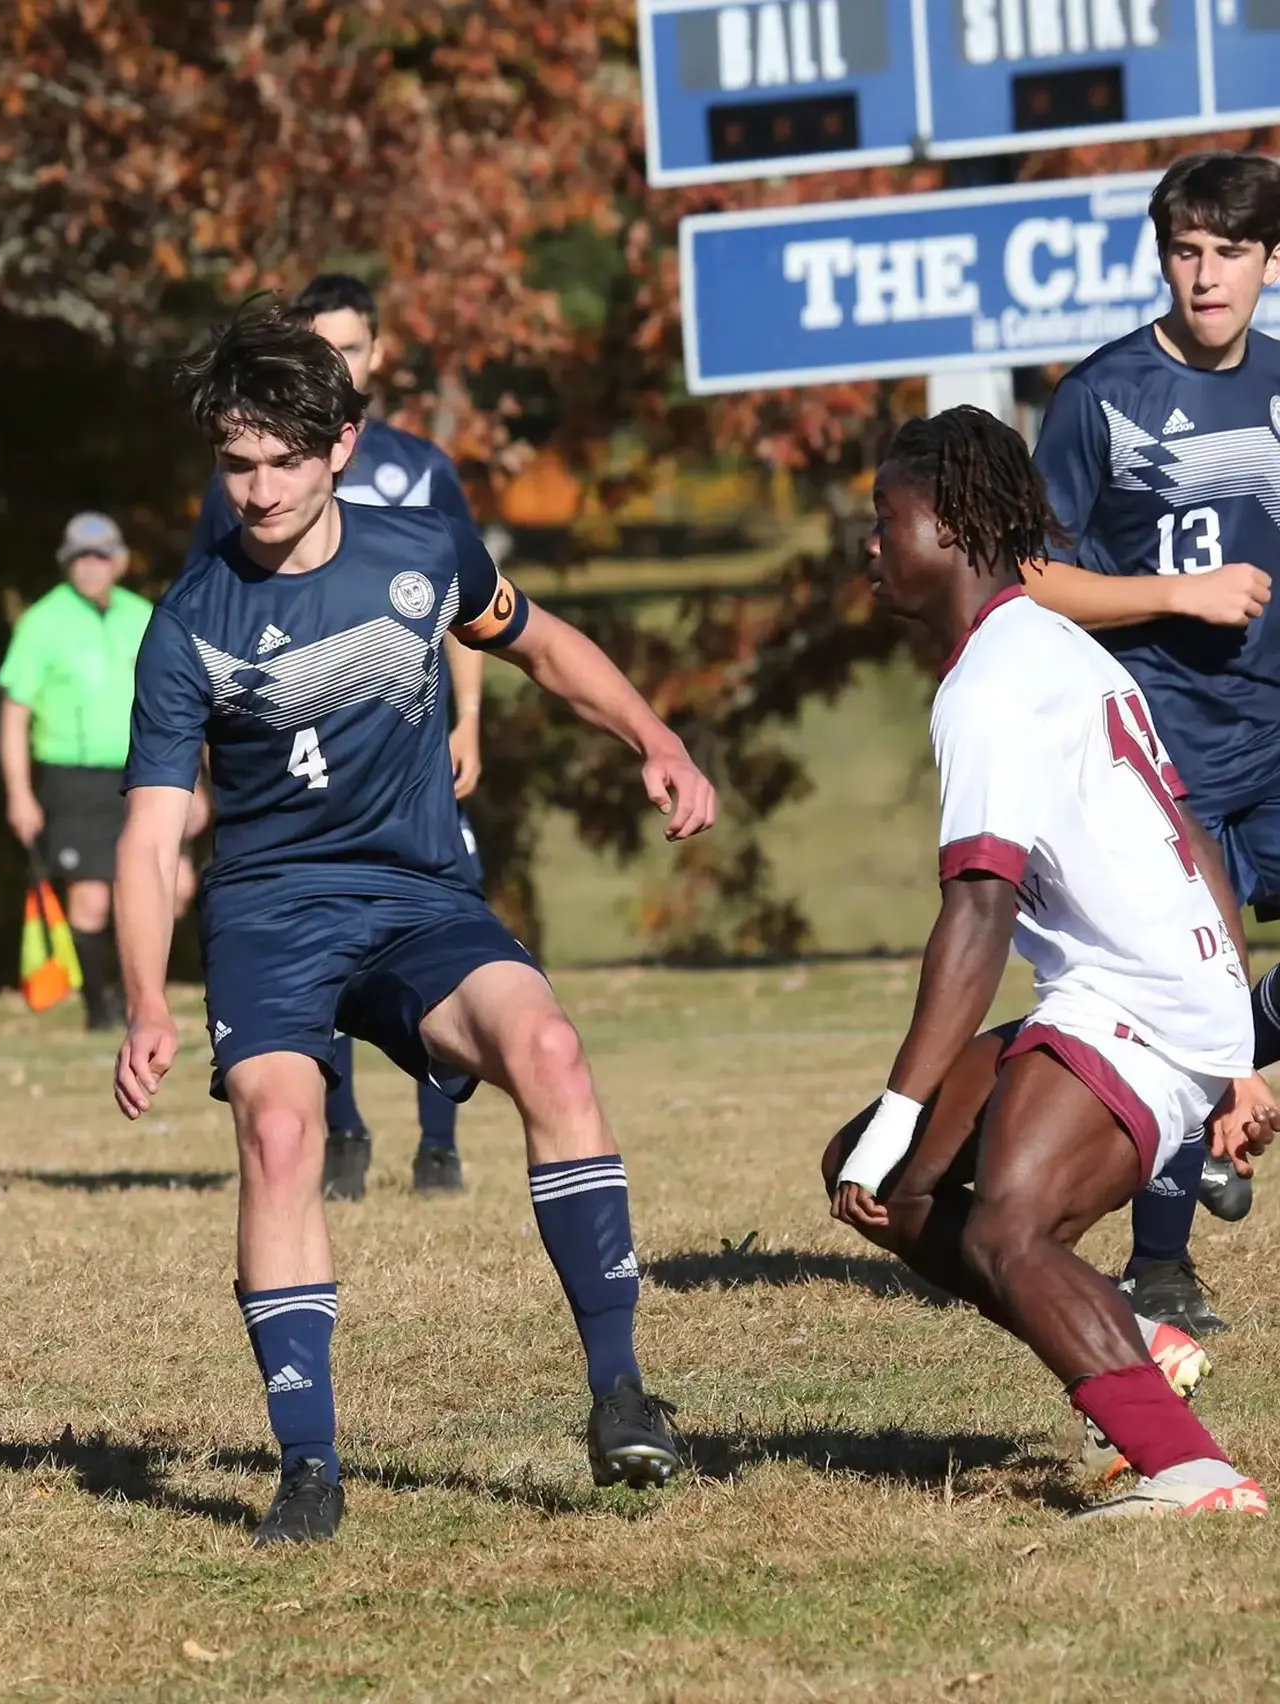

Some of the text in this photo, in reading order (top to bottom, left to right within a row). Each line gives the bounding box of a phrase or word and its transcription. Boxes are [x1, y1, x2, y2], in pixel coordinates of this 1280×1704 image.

[717, 0, 847, 91] BALL
[962, 0, 1159, 65] STRIKE
[783, 233, 979, 330] THE
[1162, 421, 1195, 435] adidas
[1157, 507, 1223, 576] 13
[257, 635, 292, 655] adidas
[287, 727, 329, 789] 4
